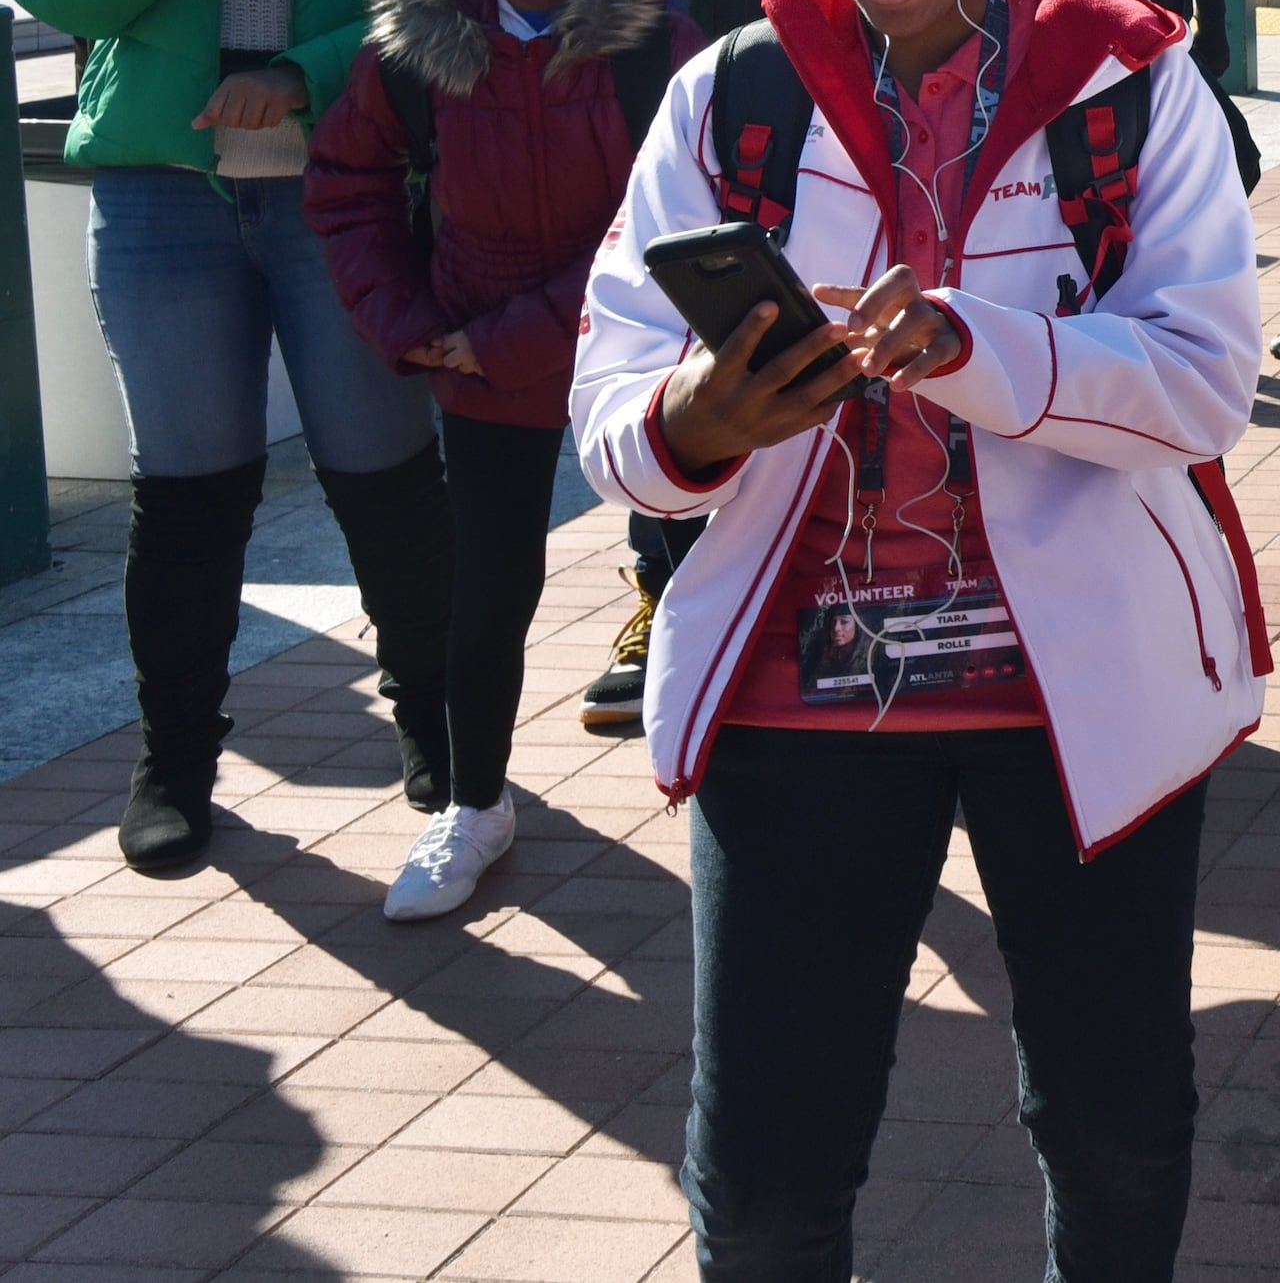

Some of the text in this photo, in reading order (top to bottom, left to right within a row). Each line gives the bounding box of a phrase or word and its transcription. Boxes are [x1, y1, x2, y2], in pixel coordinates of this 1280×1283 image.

[990, 181, 1042, 202] TEAM
[814, 584, 915, 607] VOLUNTEER
[936, 614, 969, 625] TIARA
[937, 638, 972, 651] ROLLE
[908, 670, 954, 683] ATLANTA
